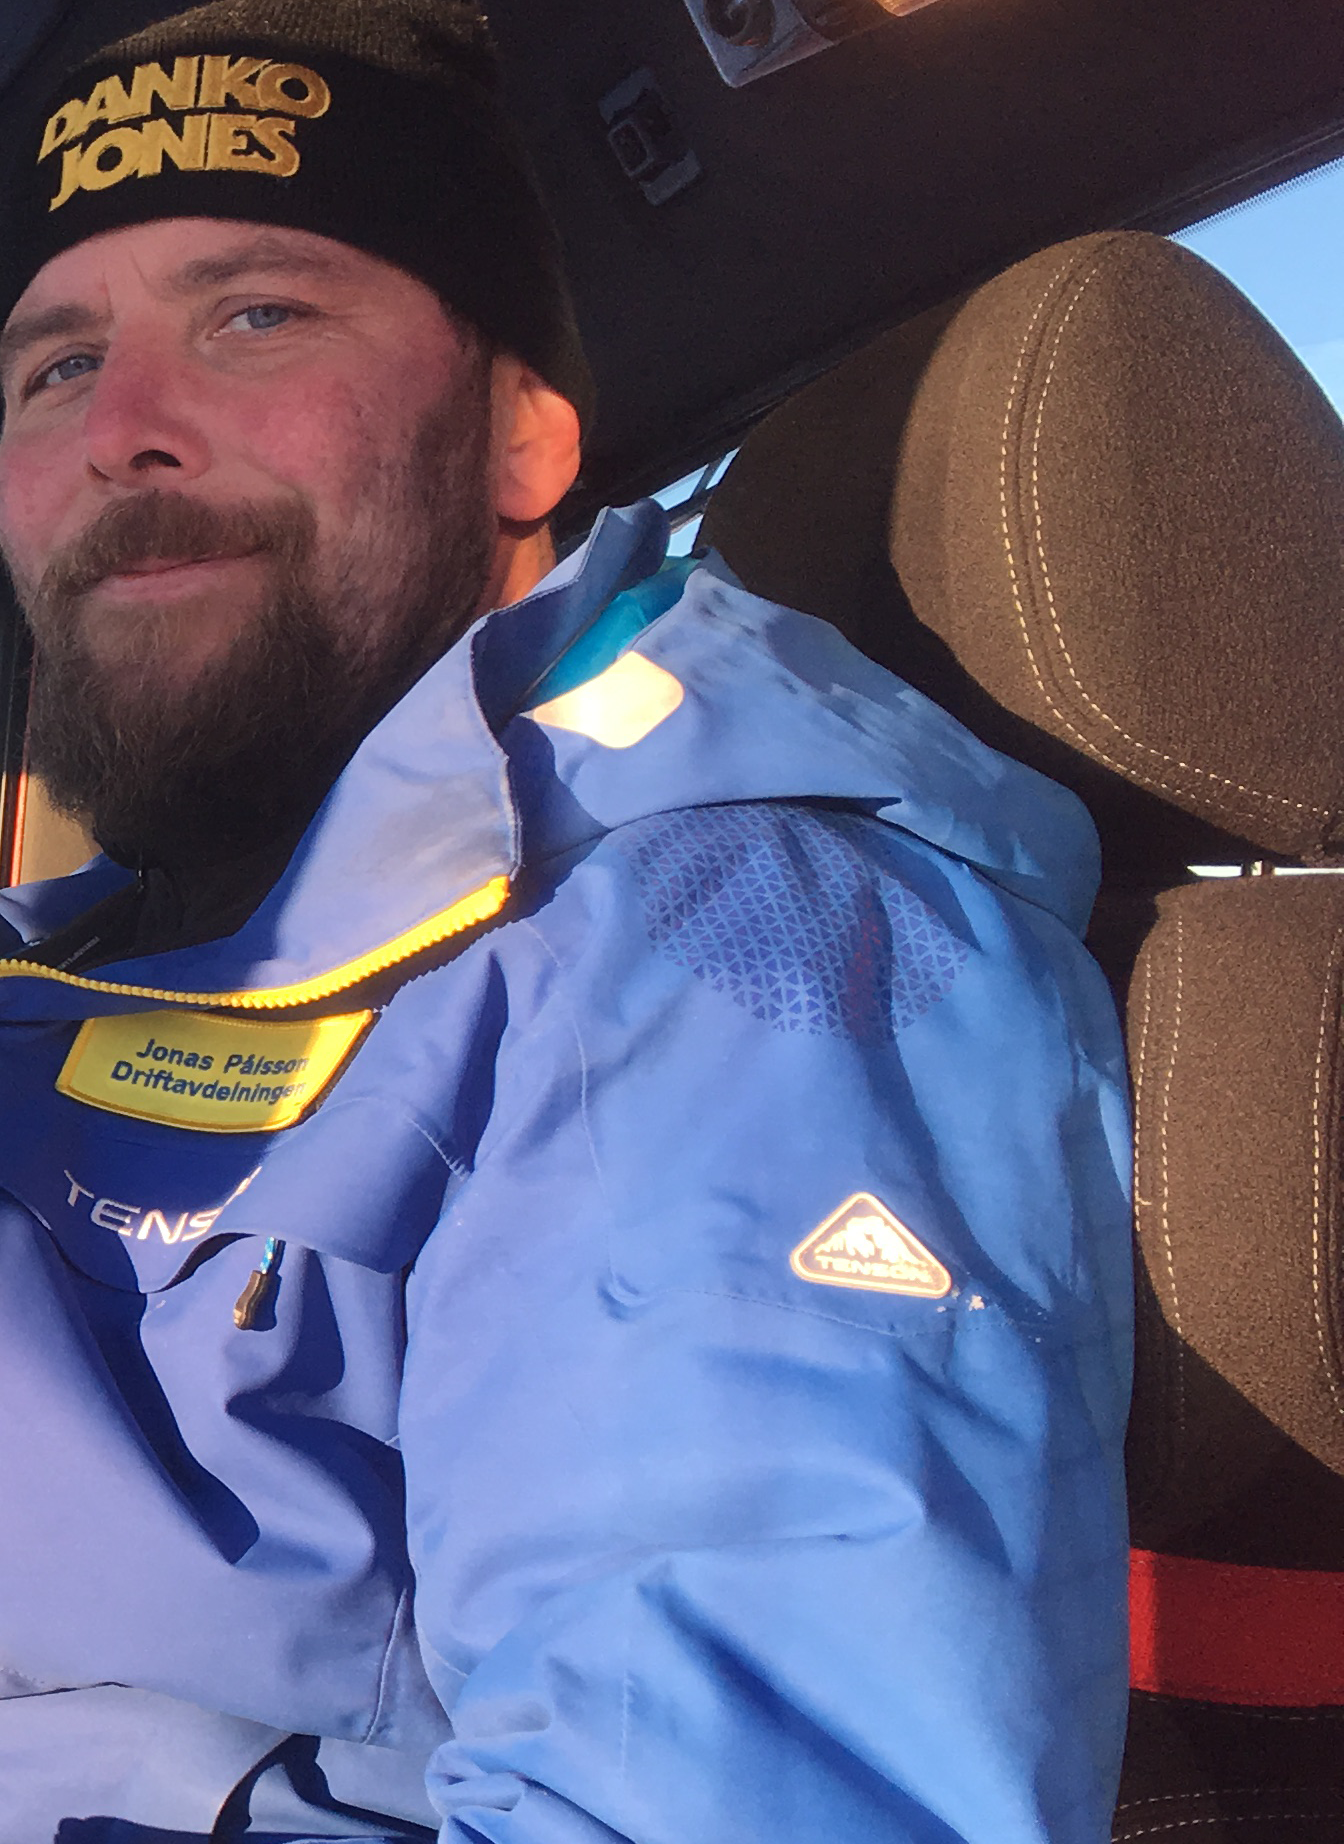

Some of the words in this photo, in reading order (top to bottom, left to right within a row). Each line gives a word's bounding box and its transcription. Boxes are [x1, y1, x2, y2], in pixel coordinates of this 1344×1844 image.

[37, 54, 332, 164] DANKO
[48, 112, 301, 213] JONES
[110, 1060, 306, 1106] Driftavdelningen
[135, 1038, 215, 1070] Jonas
[224, 1053, 310, 1076] Pålsson
[64, 1166, 262, 1245] TENS
[814, 1254, 933, 1284] TENSON
